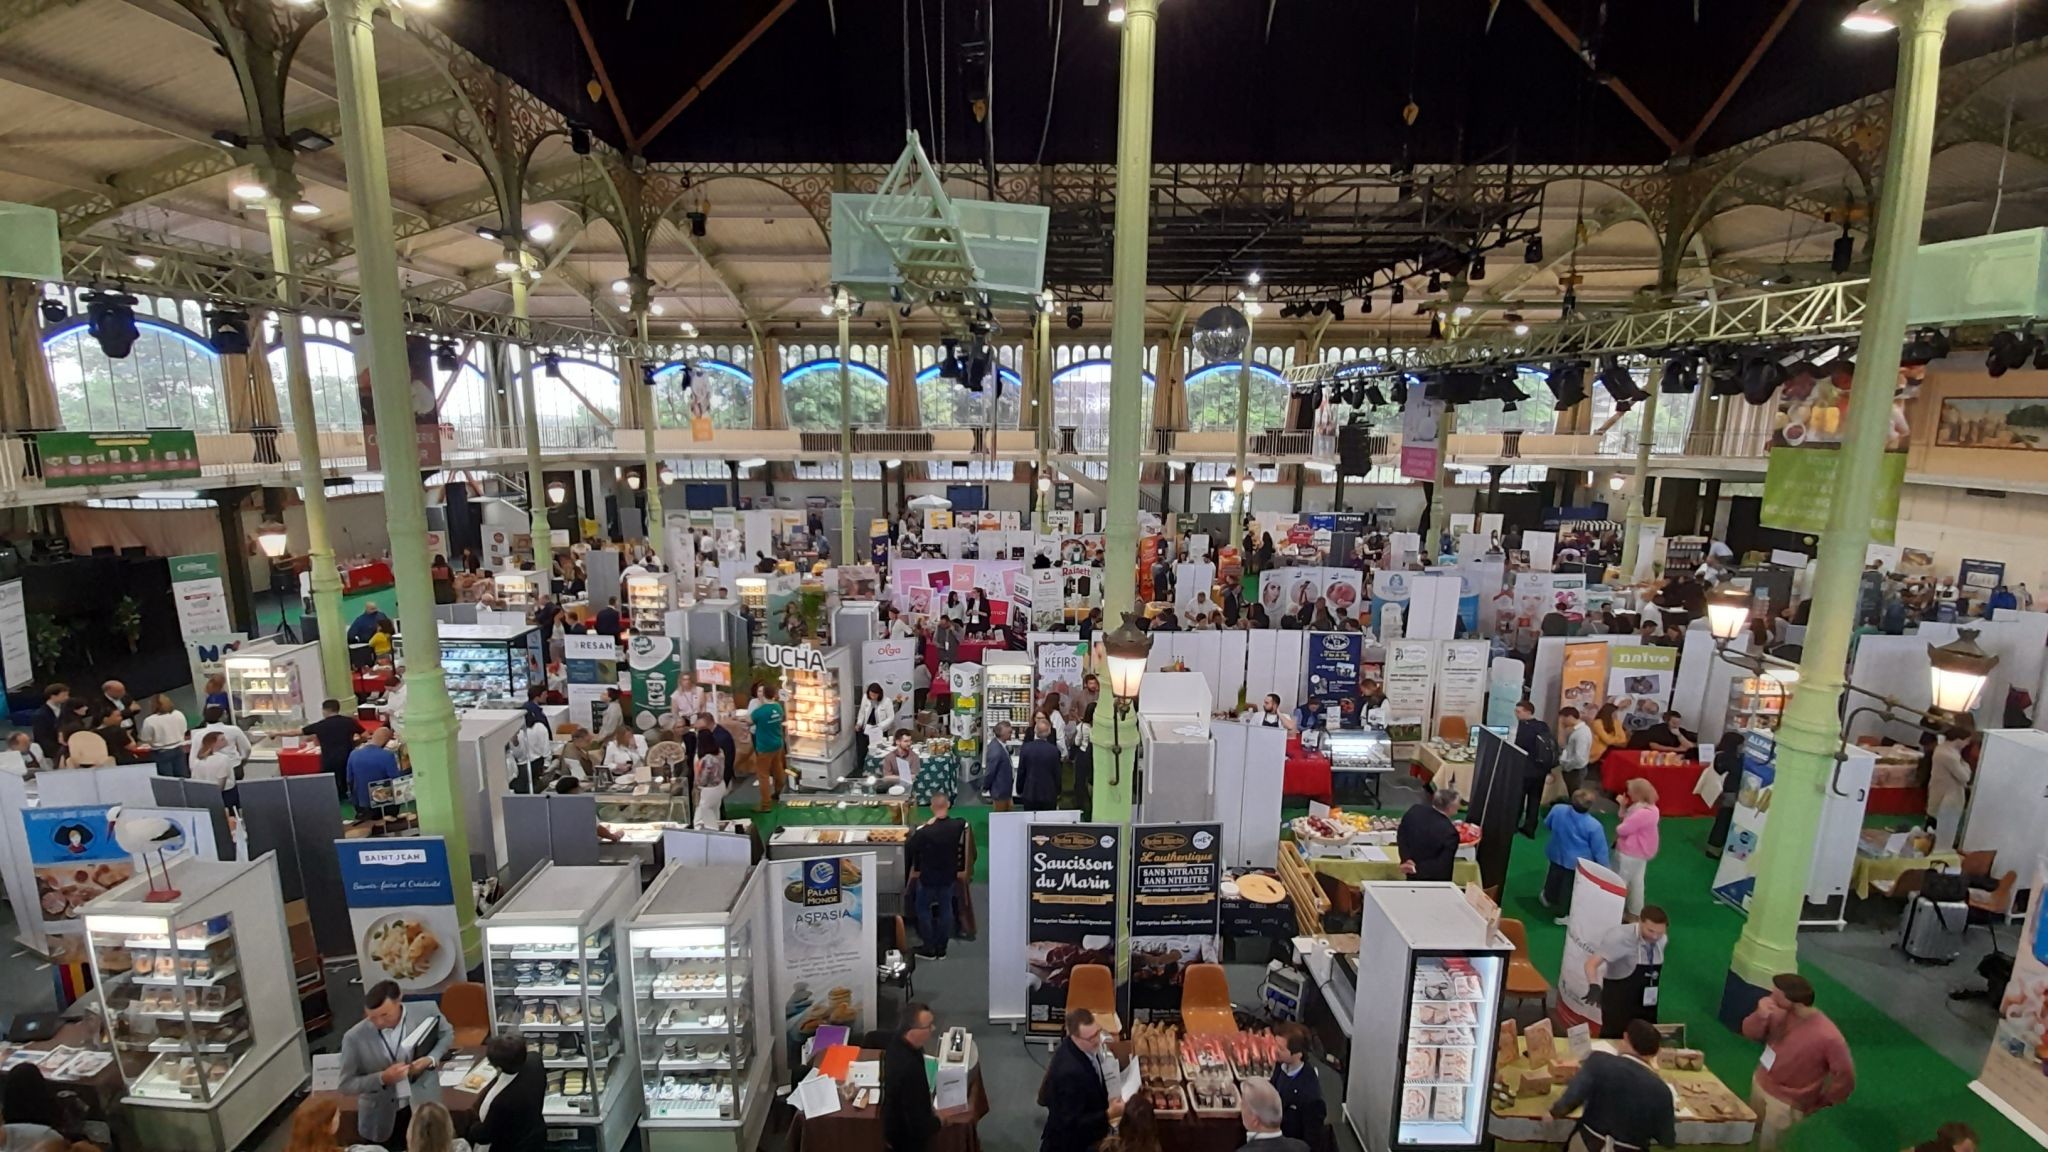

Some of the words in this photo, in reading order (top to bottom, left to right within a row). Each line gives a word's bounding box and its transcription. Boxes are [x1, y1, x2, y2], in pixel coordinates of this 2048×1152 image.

[1045, 653, 1077, 668] KÉFIRS
[365, 854, 393, 862] SAINT
[1033, 852, 1114, 872] Saucisson
[1143, 868, 1166, 877] SANS
[1167, 867, 1209, 876] NITRATES
[1035, 873, 1057, 888] du
[1057, 872, 1111, 891] Marin
[1144, 877, 1166, 885] SANS
[1168, 876, 1208, 885] NITRITES
[807, 889, 838, 897] PALAIS
[807, 895, 838, 904] MONDE
[796, 909, 852, 923] ASPASIA
